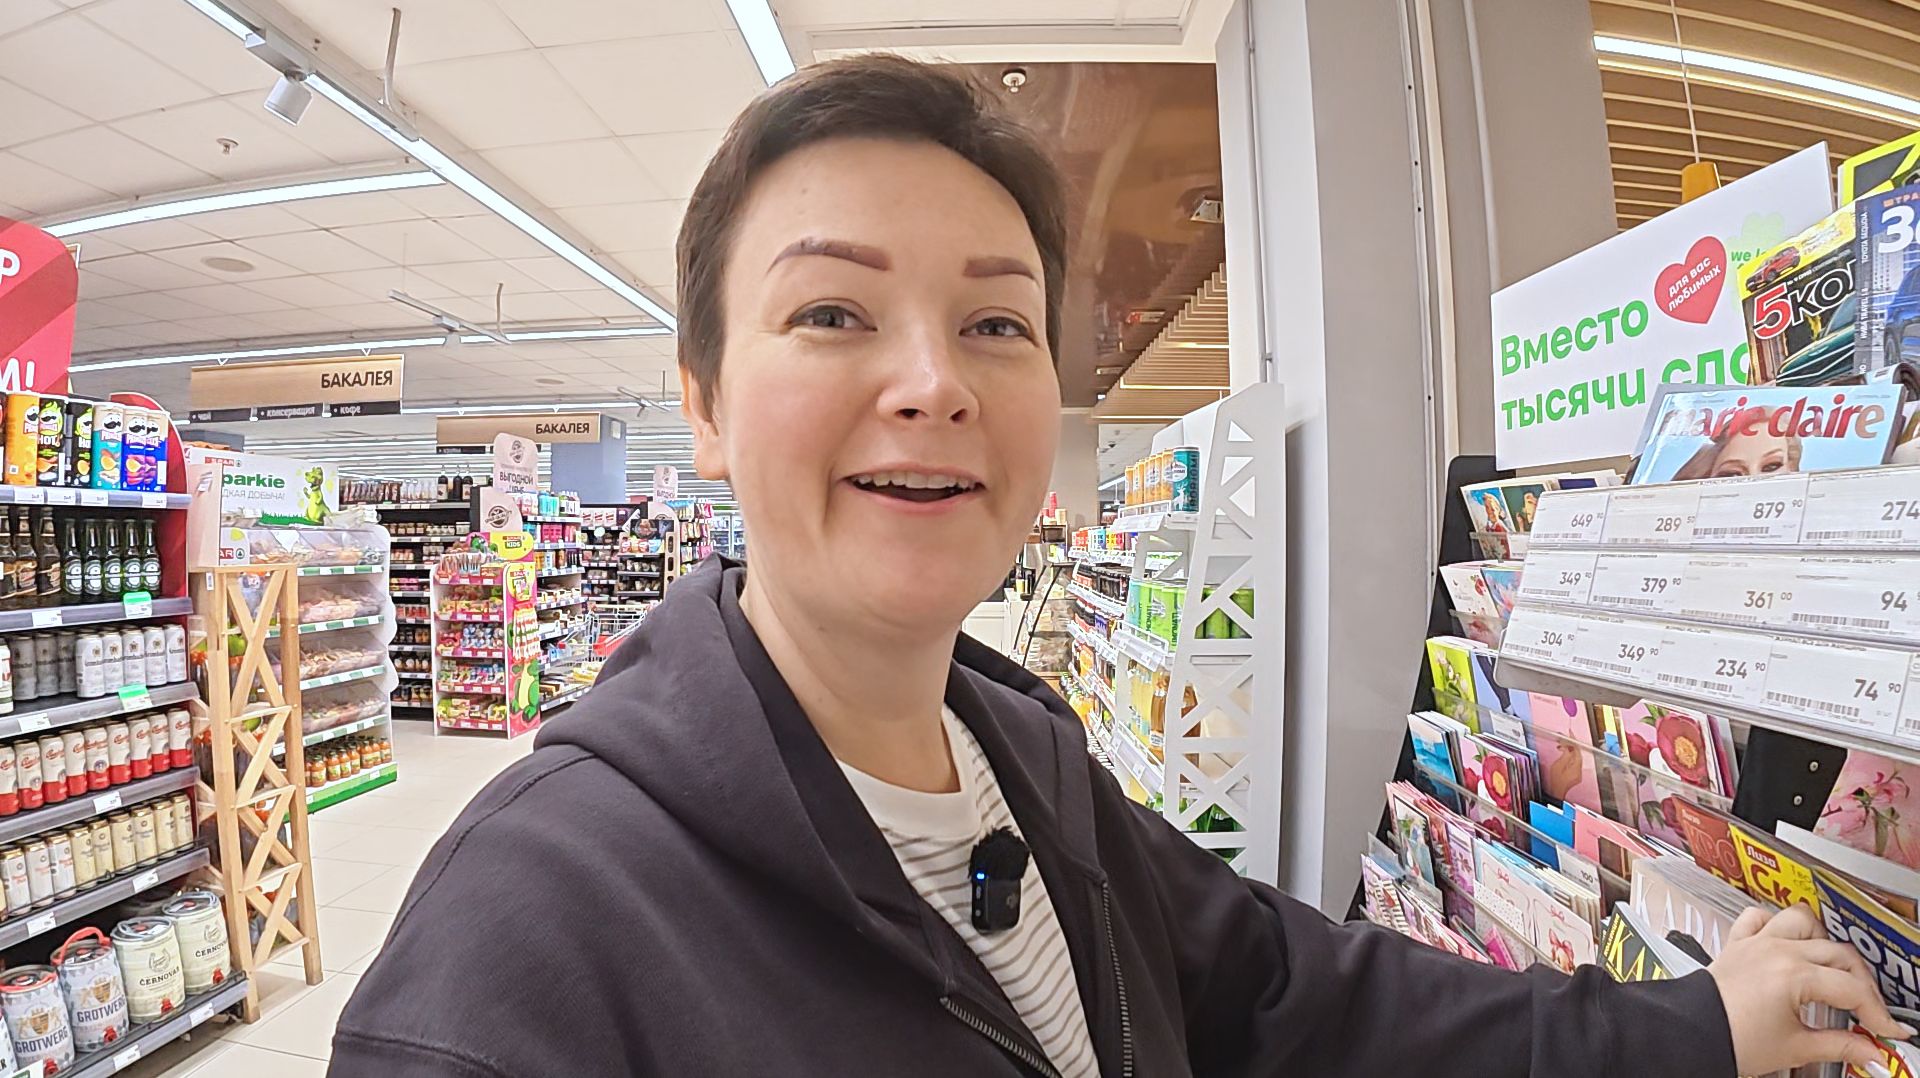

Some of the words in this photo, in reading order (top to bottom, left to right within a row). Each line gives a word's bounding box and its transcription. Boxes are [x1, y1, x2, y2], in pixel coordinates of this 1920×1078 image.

[1731, 250, 1752, 262] we
[1668, 275, 1690, 298] для
[1689, 257, 1712, 279] вас
[1668, 265, 1721, 311] любимых
[1500, 300, 1649, 377] Вместо
[321, 370, 393, 389] БАКАЛЕЯ
[1501, 368, 1647, 430] тысячи
[340, 404, 361, 417] кофе
[1767, 393, 1885, 440] claire
[535, 422, 590, 434] БАКАЛЕЯ
[222, 473, 285, 489] parkie
[247, 490, 286, 500] ДОБЫЧА!
[1752, 501, 1785, 520] 879
[1791, 499, 1803, 508] 90
[1881, 501, 1920, 521] 274
[1571, 513, 1594, 528] 649
[1655, 517, 1682, 532] 289
[1559, 571, 1581, 586] 349
[1641, 577, 1668, 594] 379
[1744, 590, 1774, 609] 361
[1780, 591, 1793, 601] 00
[1881, 590, 1908, 612] 94
[1541, 630, 1563, 647] 304
[1618, 643, 1645, 662] 349
[1715, 658, 1748, 679] 234
[1754, 662, 1766, 672] 90
[1853, 678, 1879, 701] 74
[1888, 682, 1902, 694] 90
[1746, 845, 1778, 869] Лиза
